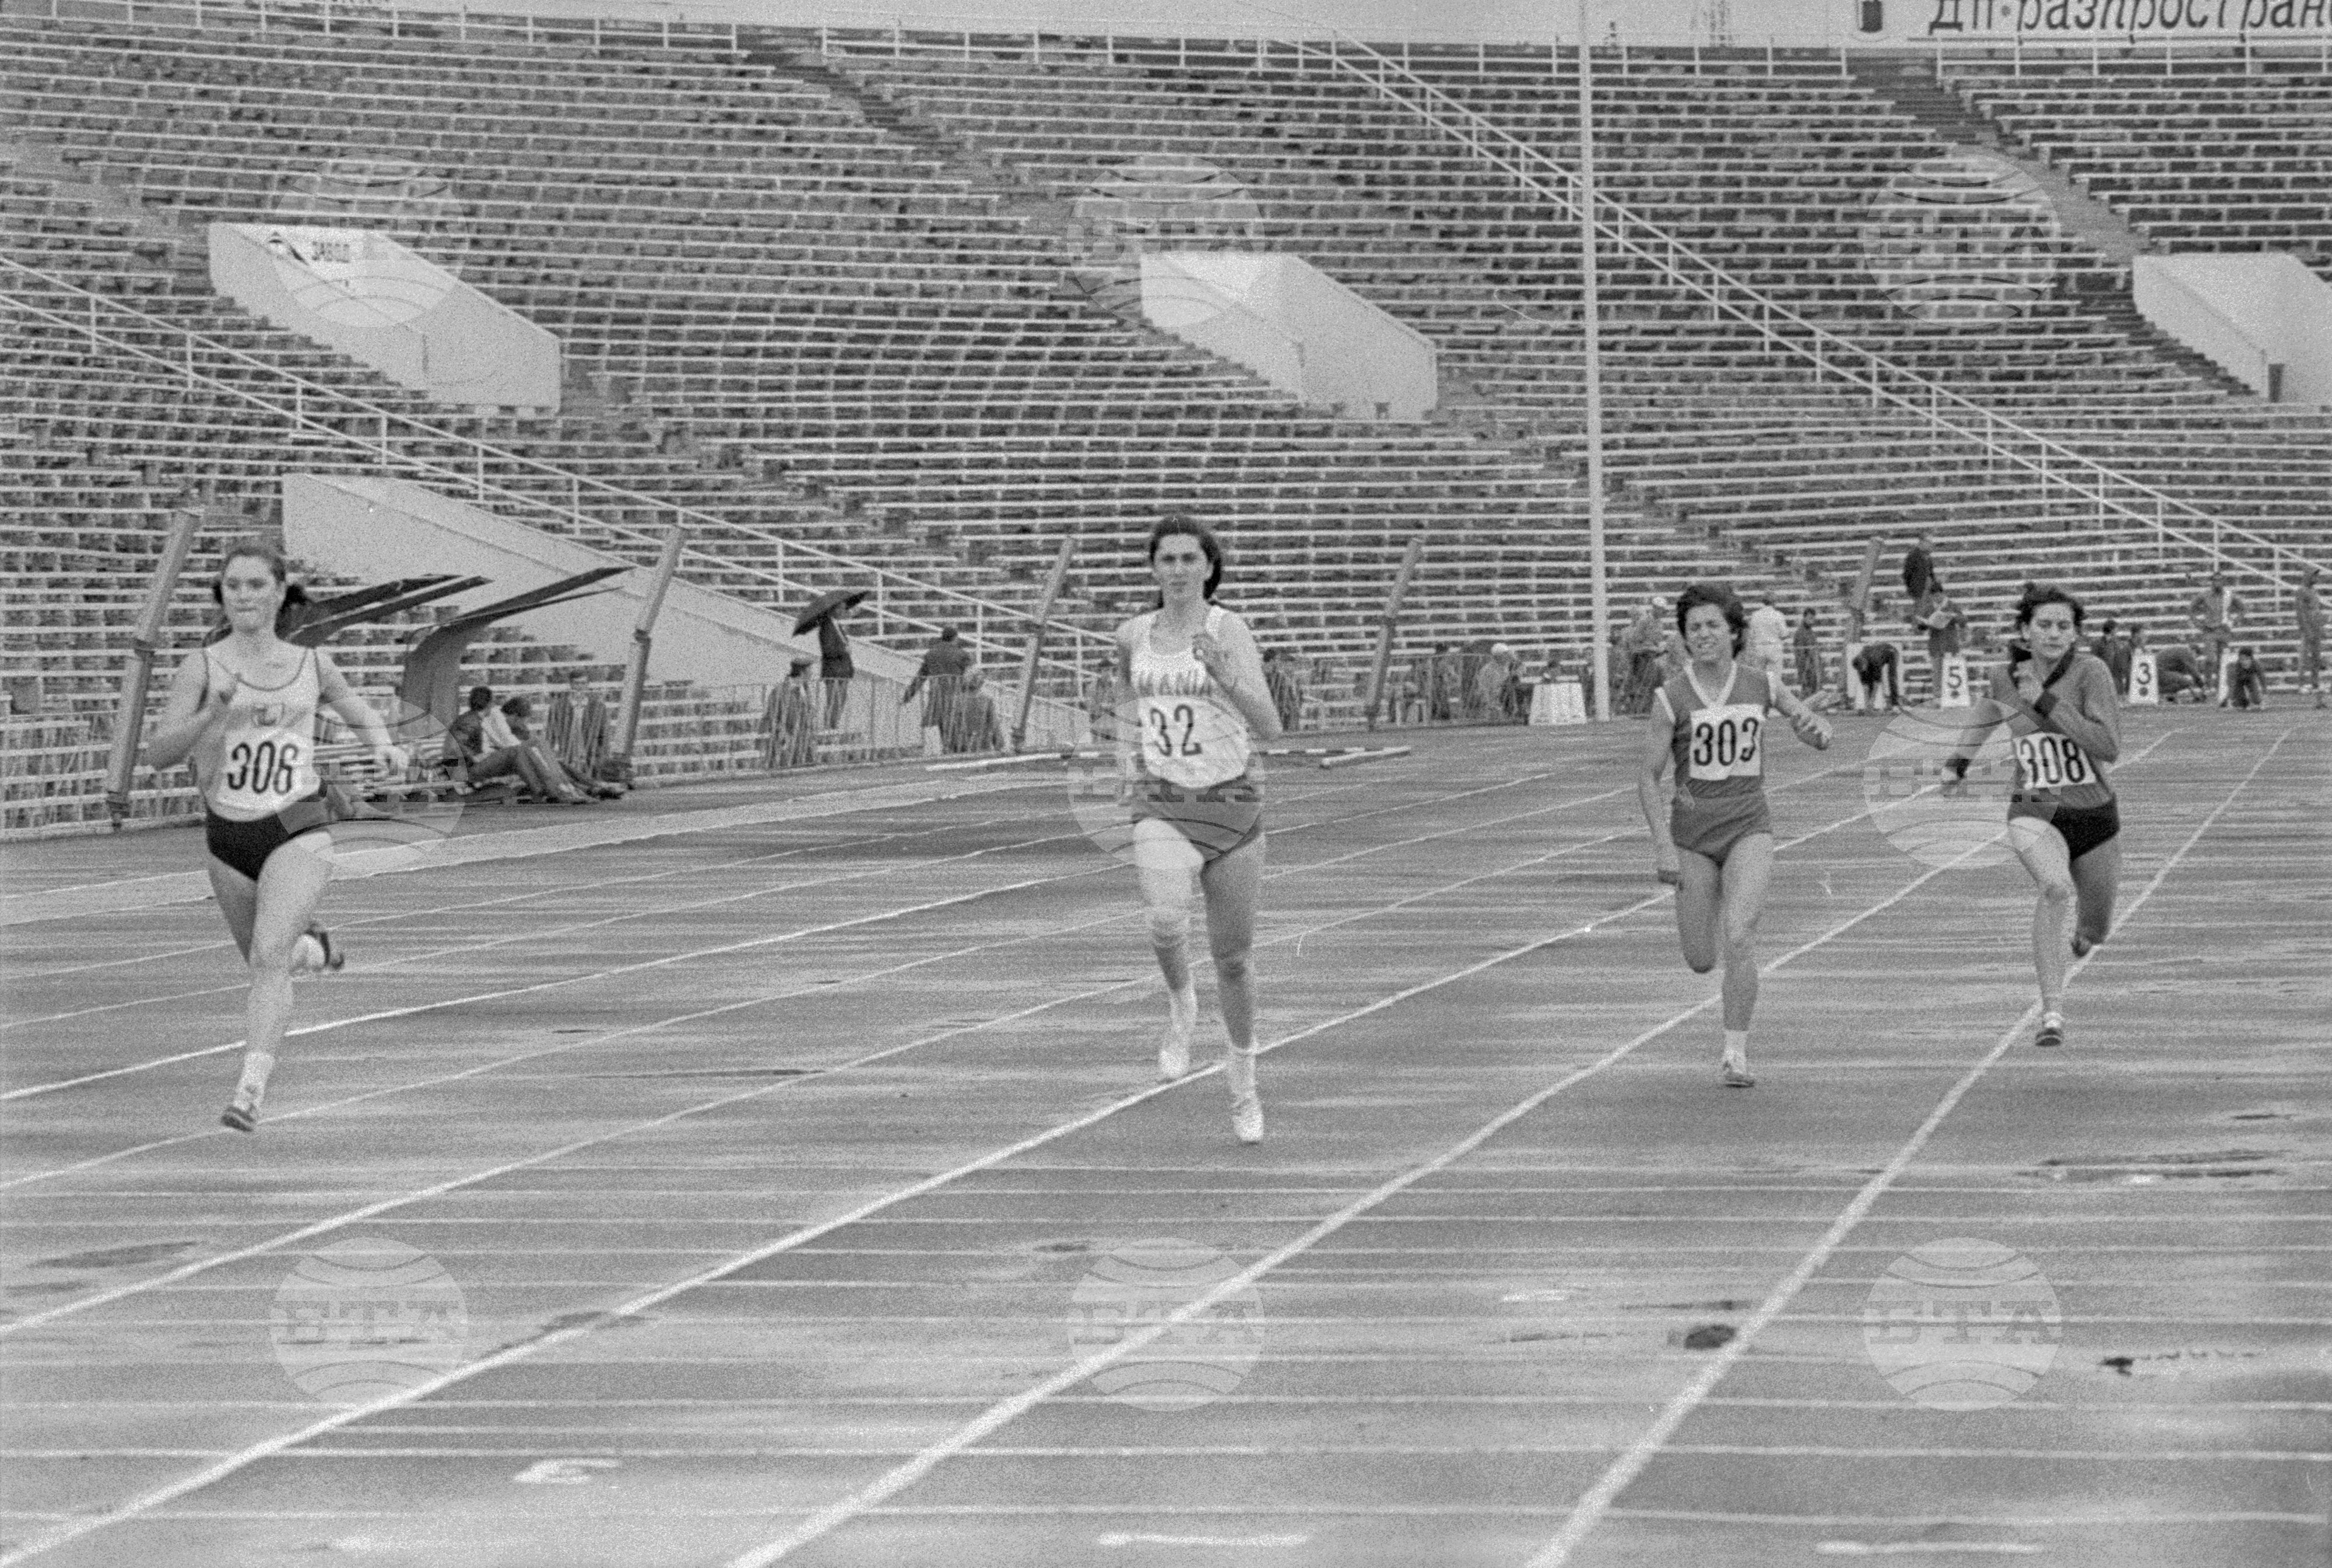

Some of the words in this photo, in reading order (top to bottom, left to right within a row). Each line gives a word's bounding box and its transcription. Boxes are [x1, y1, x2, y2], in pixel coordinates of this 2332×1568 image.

[1947, 666, 1962, 688] 5
[2136, 662, 2151, 685] 3
[1149, 703, 1203, 757] 32
[1694, 717, 1759, 767] 303
[227, 740, 299, 794] 306
[2020, 736, 2086, 785] 308
